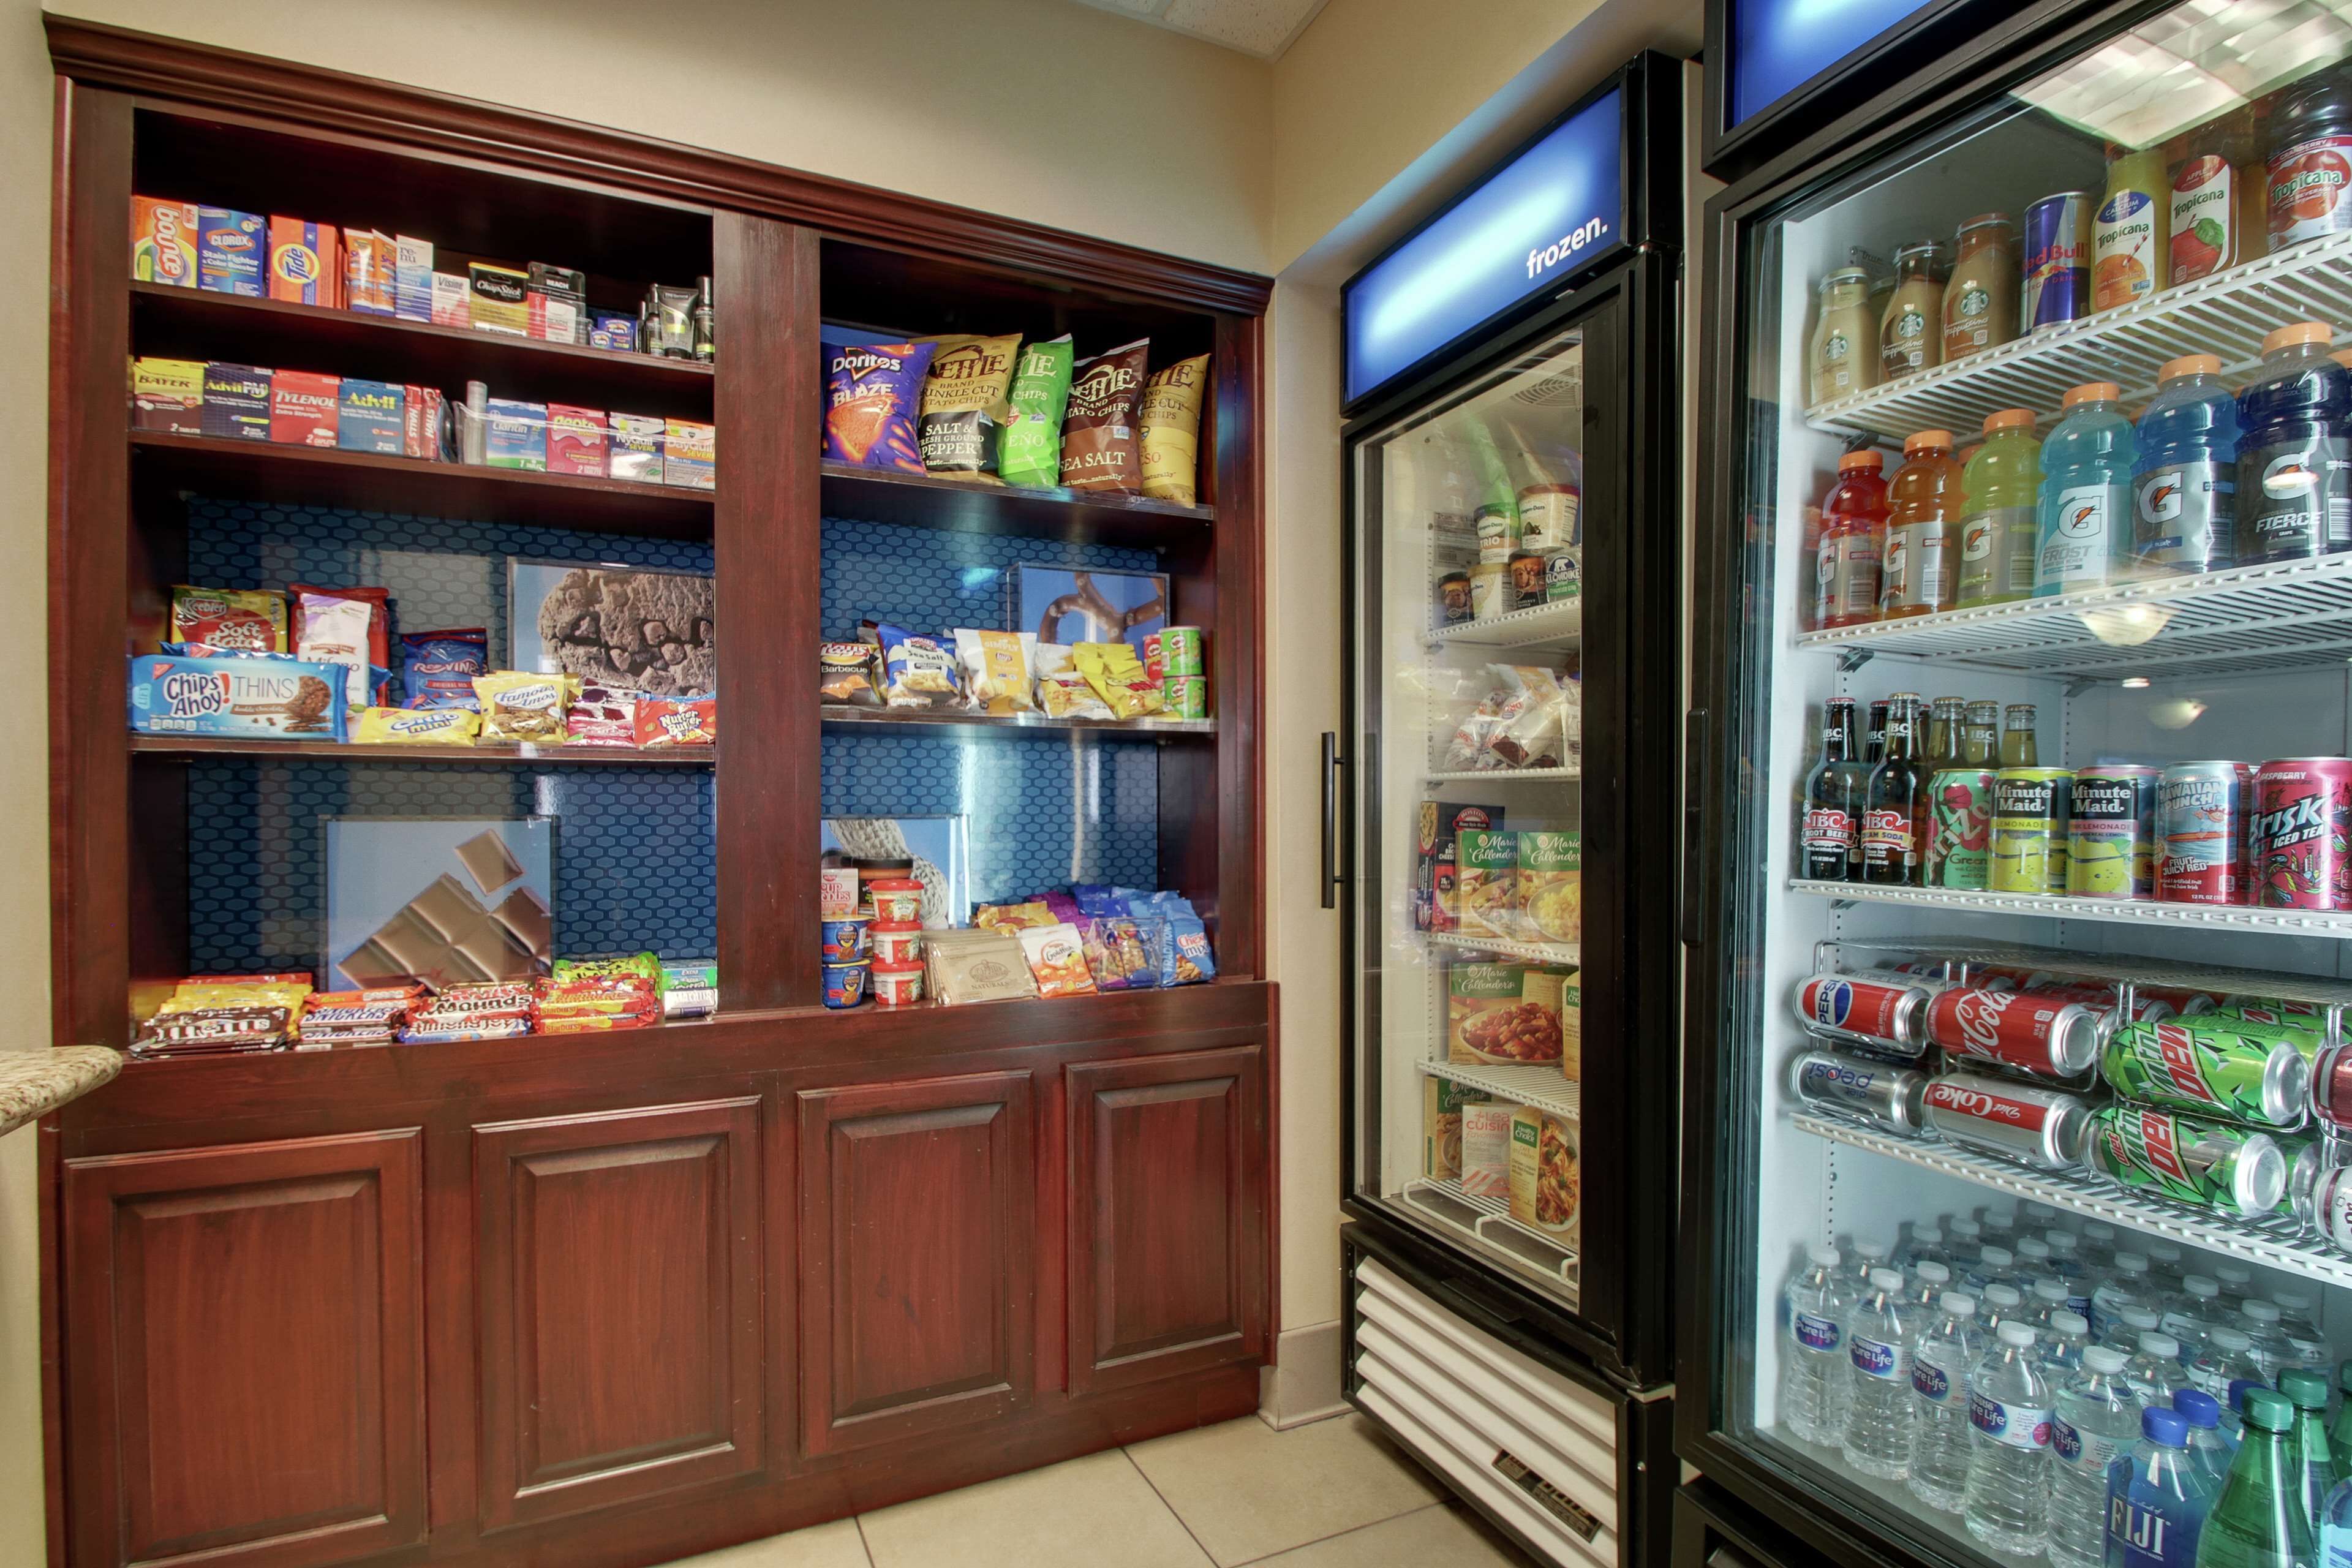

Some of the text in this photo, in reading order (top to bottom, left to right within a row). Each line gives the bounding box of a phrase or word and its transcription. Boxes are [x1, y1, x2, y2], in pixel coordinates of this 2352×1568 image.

[2271, 170, 2342, 205] Tropicana
[2174, 189, 2225, 219] Tropicana
[157, 207, 182, 274] bounce
[211, 235, 251, 246] CLOROX
[2097, 223, 2149, 249] Tropicana
[1526, 217, 1608, 279] frozen.
[202, 250, 259, 265] Stain Fighter
[285, 246, 304, 280] Tide
[832, 356, 902, 374] Doritos
[138, 375, 190, 388] BAYER
[206, 380, 265, 395] Advil PM
[940, 380, 974, 389] BRAND
[276, 390, 336, 407] TYLENOL
[833, 383, 894, 408] BLAZE
[922, 385, 999, 398] RINKLE CUT
[1012, 390, 1048, 401] CHIPS
[345, 393, 398, 409] Advil
[1076, 398, 1108, 409] BRAND
[1159, 398, 1184, 411] CUT
[1098, 402, 1130, 417] CHIPS
[1148, 411, 1177, 420] CHIPS
[409, 407, 419, 437] HALLS
[425, 409, 435, 439] HALLS
[925, 422, 973, 436] SALT &
[306, 435, 312, 443] 2
[919, 434, 984, 447] RESH GROUND
[922, 442, 978, 459] PEPPER
[1085, 451, 1126, 467] SALT
[2138, 471, 2184, 524] G
[2058, 494, 2102, 539] G
[2255, 511, 2324, 533] FIERCE
[1480, 537, 1500, 548] TRIO
[1962, 516, 1992, 562] G
[1883, 530, 1910, 573] G
[2042, 546, 2094, 564] FROST
[1817, 545, 1836, 584] G
[1546, 569, 1580, 584] KLONDIKE
[186, 598, 226, 612] Keebler
[216, 622, 260, 637] Soft
[984, 641, 1020, 652] SIMPLY
[167, 676, 219, 700] Chips
[234, 676, 294, 698] THINS
[499, 684, 556, 703] Famous
[521, 693, 557, 706] Amos
[393, 713, 459, 730] OREO
[661, 710, 699, 726] Nutter
[409, 719, 451, 734] mini
[1994, 785, 2052, 799] Minute
[2073, 785, 2132, 799] Minute
[1999, 799, 2043, 812] Maid
[2076, 800, 2120, 813] Maid
[2163, 794, 2215, 813] PUNCH
[1812, 815, 1842, 829] IBC
[1870, 815, 1895, 829] IBC
[1826, 829, 1849, 840] BEER
[1882, 831, 1904, 841] SODA
[2273, 824, 2325, 849] ICED TEA
[1481, 835, 1517, 852] Marie
[1950, 854, 1987, 865] Green
[2169, 857, 2194, 867] FRUIT
[2162, 862, 2207, 876] JUICY RED
[1177, 933, 1205, 948] Chex
[1046, 945, 1074, 961] Goldfish
[1475, 967, 1508, 980] Marie
[971, 981, 1010, 990] NATURALS
[1818, 979, 1839, 1025] PEPSI
[1809, 1063, 1875, 1089] pepsi
[1845, 1087, 1868, 1099] diet
[1935, 1085, 1993, 1116] Coke
[1993, 1103, 2020, 1118] Diet
[2107, 1132, 2128, 1164] diet
[1871, 1350, 1893, 1366] Life
[1927, 1374, 1947, 1391] Life
[1985, 1412, 2005, 1429] Life
[2111, 1496, 2165, 1555] FIJI
